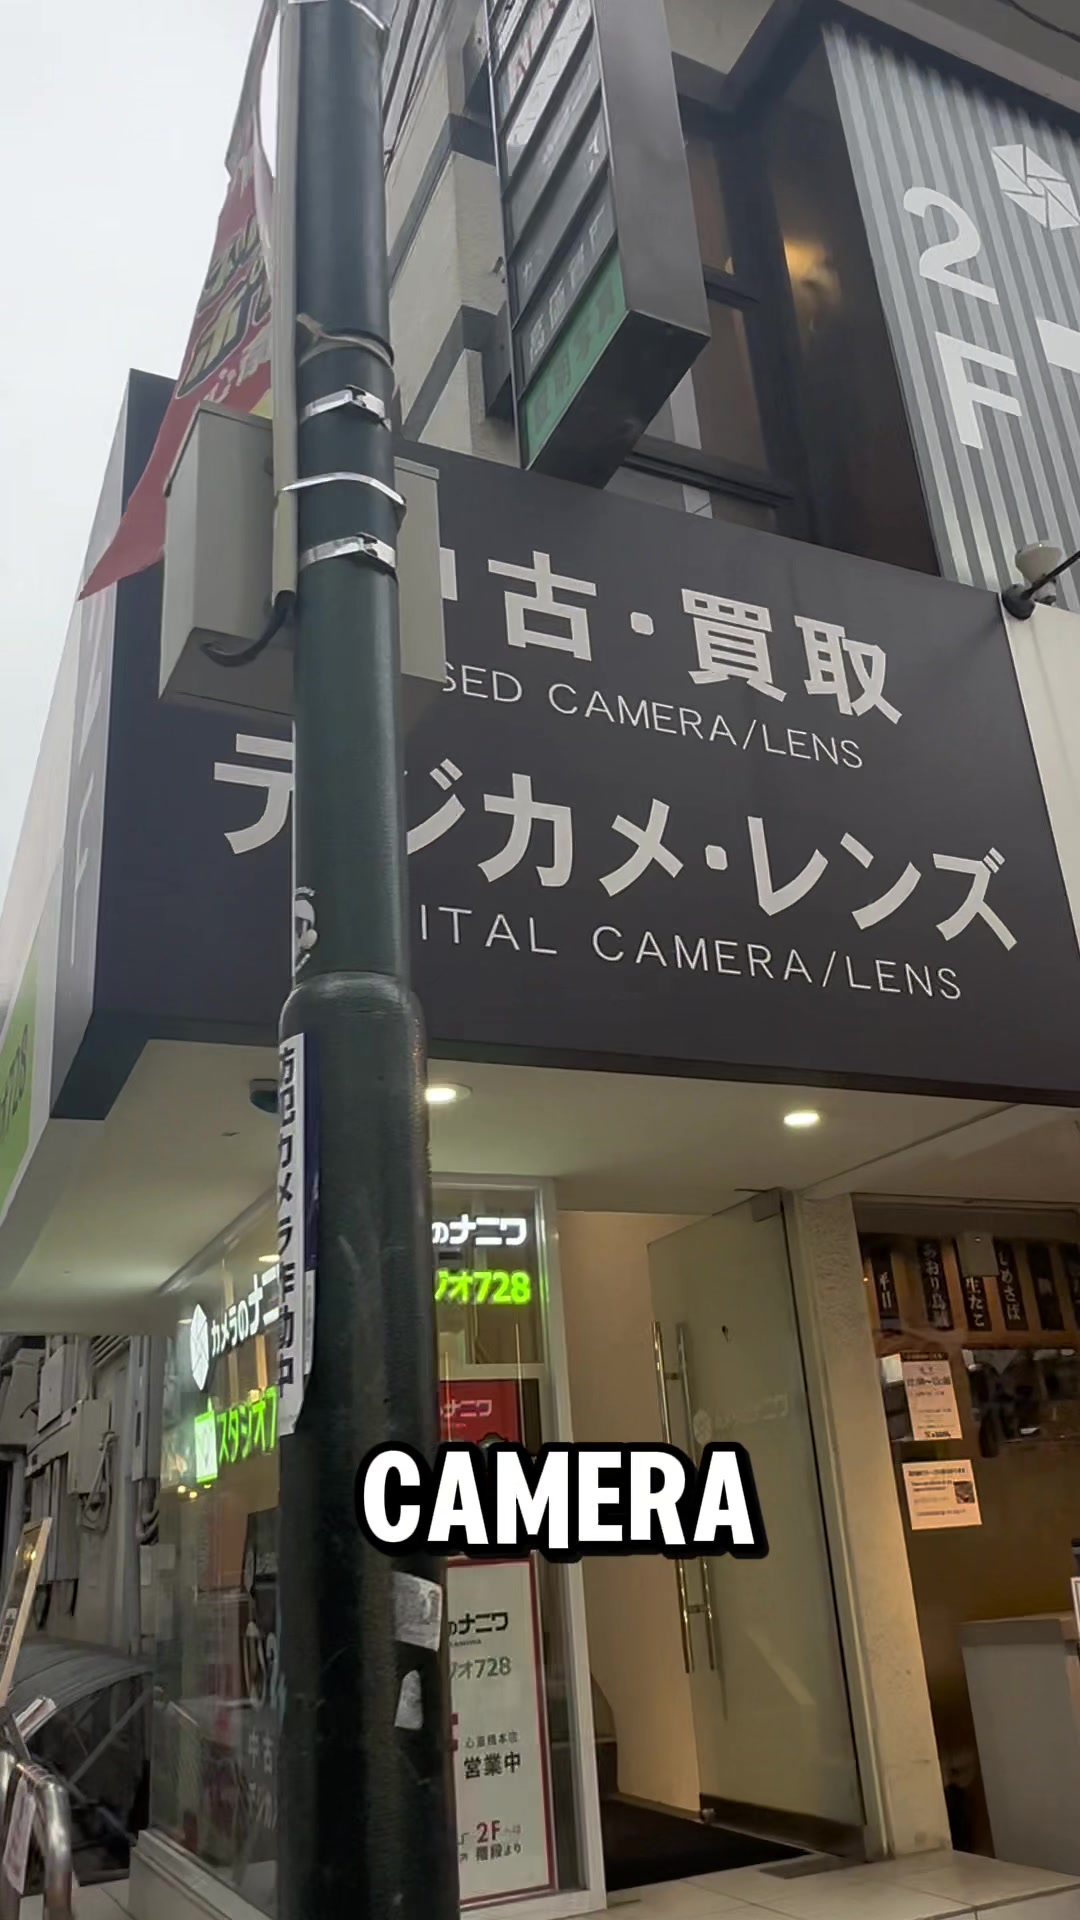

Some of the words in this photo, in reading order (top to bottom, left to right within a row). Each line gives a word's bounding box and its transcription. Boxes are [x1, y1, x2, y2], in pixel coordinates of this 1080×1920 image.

[440, 548, 902, 724] 古・買取
[442, 661, 523, 702] SED
[548, 683, 864, 769] CAMERA/LENS
[420, 904, 557, 954] ITAL
[592, 926, 962, 1000] CAMERA/LENS
[440, 1399, 492, 1418] ナニワ
[464, 1751, 521, 1779] 営業中
